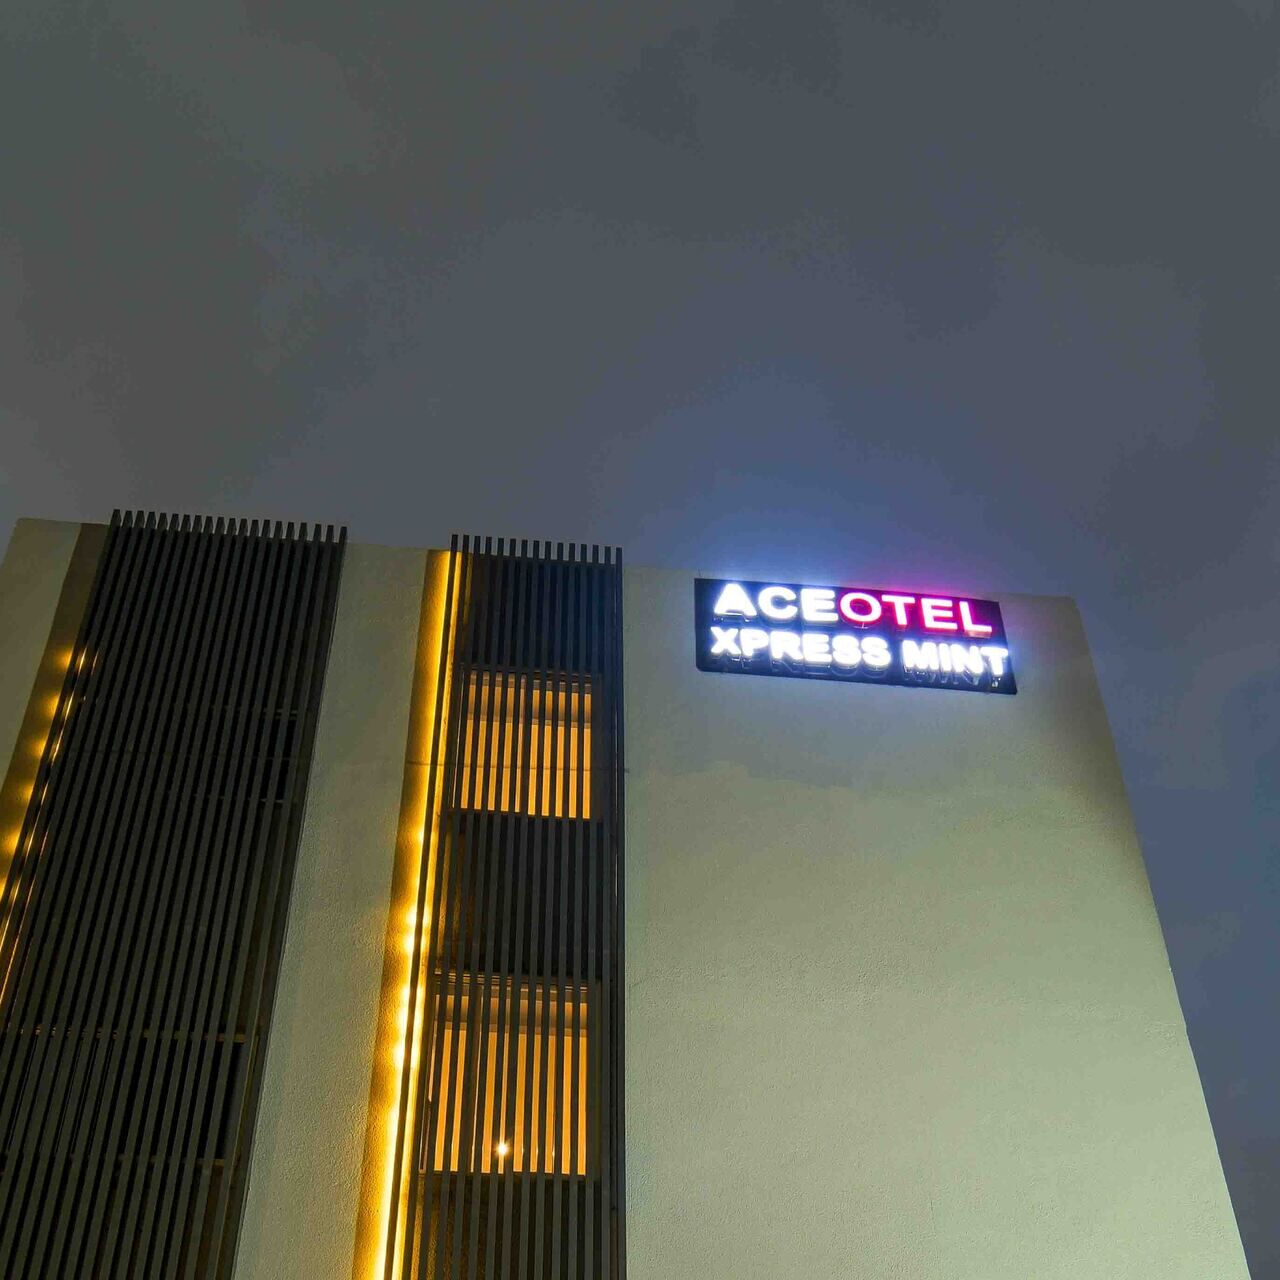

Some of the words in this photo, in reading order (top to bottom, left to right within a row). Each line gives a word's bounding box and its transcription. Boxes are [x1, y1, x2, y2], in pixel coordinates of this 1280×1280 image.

[714, 582, 992, 636] ACEOTEL
[710, 626, 892, 668] XPRESS
[902, 638, 1009, 677] MINT
